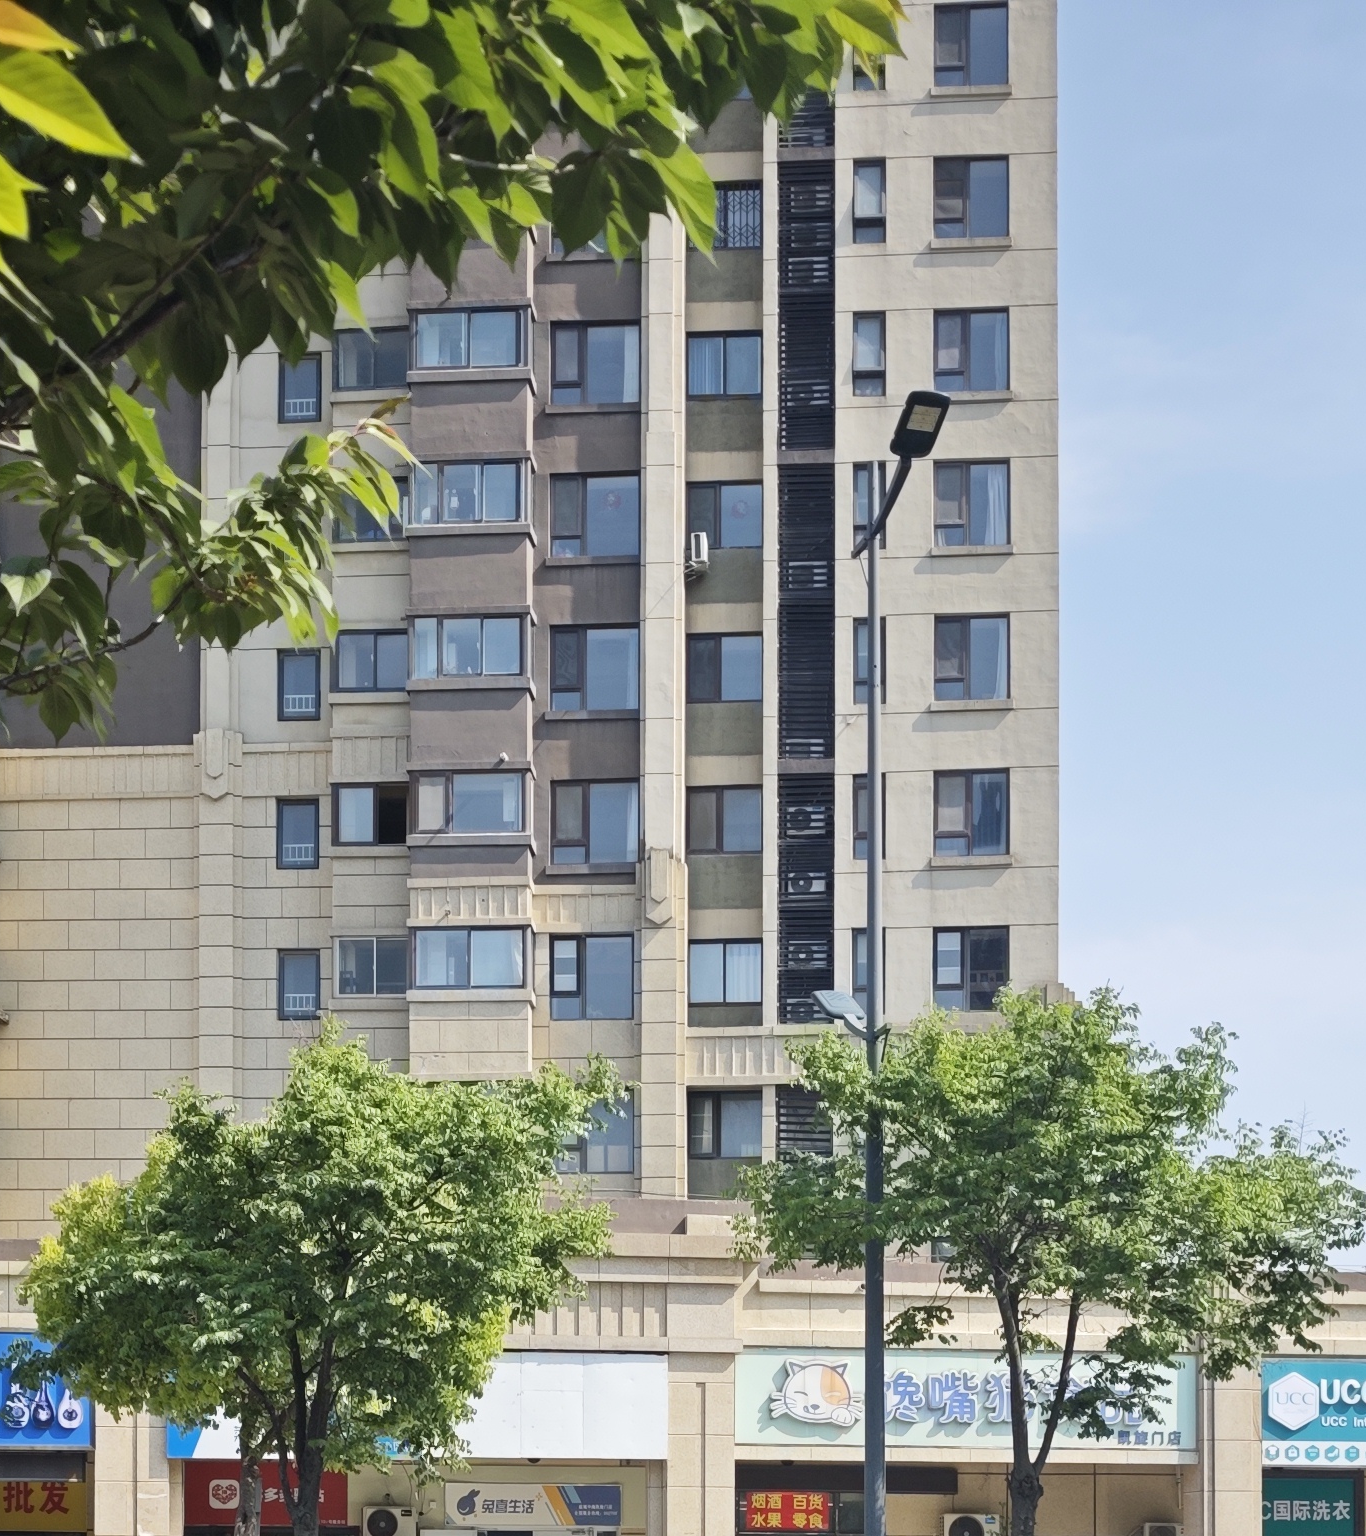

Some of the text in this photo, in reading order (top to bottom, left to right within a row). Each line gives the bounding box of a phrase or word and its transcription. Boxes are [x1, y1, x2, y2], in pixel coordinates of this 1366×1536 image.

[1275, 1391, 1315, 1406] UCC
[1321, 1416, 1348, 1427] UCC
[3, 1481, 70, 1515] 批发
[751, 1493, 824, 1511] 烟酒 百货
[482, 1499, 535, 1514] 兔喜生活
[751, 1512, 824, 1529] 水果 零食
